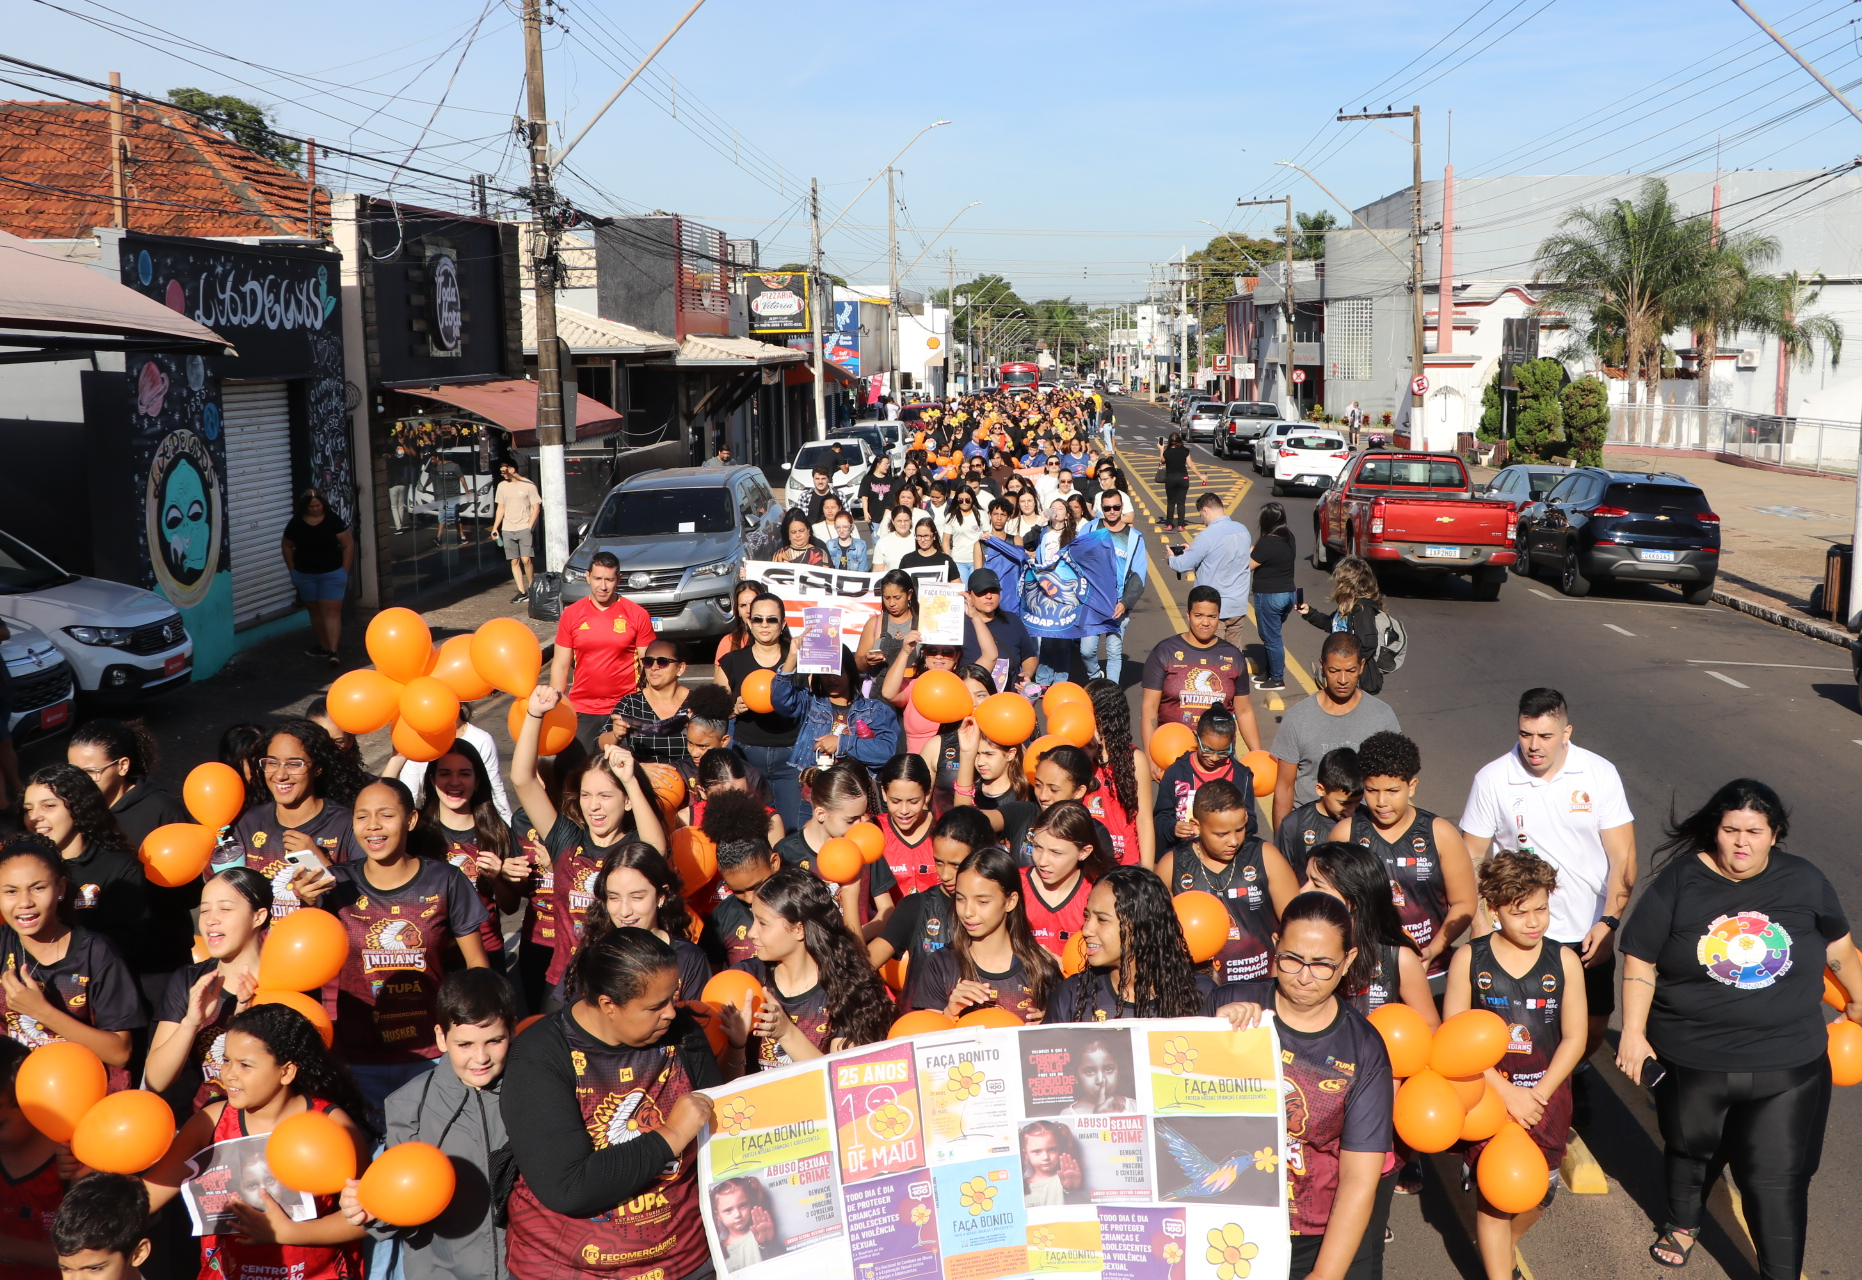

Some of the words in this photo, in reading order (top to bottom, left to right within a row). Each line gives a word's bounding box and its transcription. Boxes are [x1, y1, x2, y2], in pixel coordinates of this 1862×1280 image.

[435, 275, 457, 304] Toda
[761, 291, 794, 299] PIZZARIA
[761, 300, 794, 310] Vitória
[1059, 613, 1077, 626] FAP
[324, 837, 338, 845] TUPÃ
[425, 894, 439, 902] TUPÃ
[1423, 918, 1431, 927] DE
[364, 953, 426, 970] INDIANS
[1226, 955, 1260, 967] CENTRO
[1260, 951, 1268, 960] DE
[1226, 960, 1269, 974] FORMAÇÃO
[1227, 968, 1269, 982] ESPORTIVA
[386, 980, 422, 994] TUPÃ
[1486, 995, 1509, 1006] TUPÃ
[380, 1010, 427, 1020] FECOMERCIÁRIOS
[381, 1025, 418, 1043] HUSKER
[926, 1053, 956, 1069] FAÇA
[958, 1048, 1000, 1065] BONITO
[1029, 1052, 1071, 1065] CRIANÇA
[1037, 1062, 1064, 1073] FALA
[1334, 1061, 1356, 1072] TUPÃ
[839, 1067, 859, 1087] 25
[863, 1062, 907, 1083] ANOS
[1028, 1076, 1061, 1088] PEDIDO
[1061, 1074, 1075, 1085] DE
[1031, 1084, 1074, 1097] SOCORRO
[1184, 1078, 1217, 1096] FAÇA
[1218, 1077, 1267, 1092] BONITO.
[841, 1085, 914, 1150] 18
[1077, 1117, 1108, 1129] ABUSO
[1110, 1118, 1142, 1130] SEXUAL
[741, 1132, 773, 1151] FAÇA
[774, 1118, 820, 1143] BONITO.
[1078, 1132, 1099, 1140] INFANTIL
[1103, 1131, 1107, 1142] É
[1110, 1130, 1143, 1143] CRIME
[847, 1149, 868, 1173] DE
[871, 1139, 917, 1168] MAIO
[766, 1160, 796, 1177] ABUSO
[799, 1155, 830, 1171] SEXUAL
[768, 1179, 789, 1189] INFANTIL
[791, 1175, 796, 1186] É
[799, 1167, 831, 1185] CRIME
[808, 1186, 831, 1197] DENUNCIE
[845, 1192, 864, 1203] TODO
[864, 1189, 876, 1198] DIA
[877, 1186, 882, 1196] É
[882, 1185, 895, 1194] DIA
[617, 1187, 669, 1217] TUPÃ
[811, 1199, 833, 1209] PROCURE
[847, 1204, 856, 1213] DE
[857, 1196, 891, 1210] PROTEGER
[614, 1212, 644, 1223] ESTÂNCIA
[646, 1205, 671, 1218] TURÍSTICA
[810, 1206, 834, 1217] CONSELHO
[815, 1212, 835, 1223] TUTELAR
[848, 1208, 881, 1222] CRIANÇAS
[882, 1206, 887, 1214] E
[1100, 1214, 1117, 1222] TODO
[1118, 1214, 1130, 1222] DIA
[1131, 1212, 1136, 1222] É
[1137, 1214, 1149, 1223] DIA
[849, 1213, 900, 1233] ADOLESCENTES
[952, 1218, 979, 1233] FAÇA
[980, 1212, 1014, 1228] BONITO
[1110, 1224, 1145, 1232] PROTEGER
[850, 1232, 860, 1242] DA
[861, 1224, 896, 1239] VIOLÊNCIA
[1101, 1233, 1134, 1243] CRIANÇAS
[1135, 1234, 1140, 1242] E
[600, 1235, 677, 1261] FECOMERCIÁRIOS
[851, 1239, 878, 1252] SEXUAL
[1101, 1244, 1152, 1253] ADOLESCENTES
[1045, 1250, 1068, 1261] FAÇA
[1067, 1250, 1099, 1260] BONITO.
[1102, 1253, 1112, 1261] DA
[1113, 1252, 1147, 1263] VIOLÊNCIA
[241, 1264, 288, 1275] CENTRO
[290, 1262, 306, 1273] DE
[1102, 1263, 1128, 1271] SEXUAL
